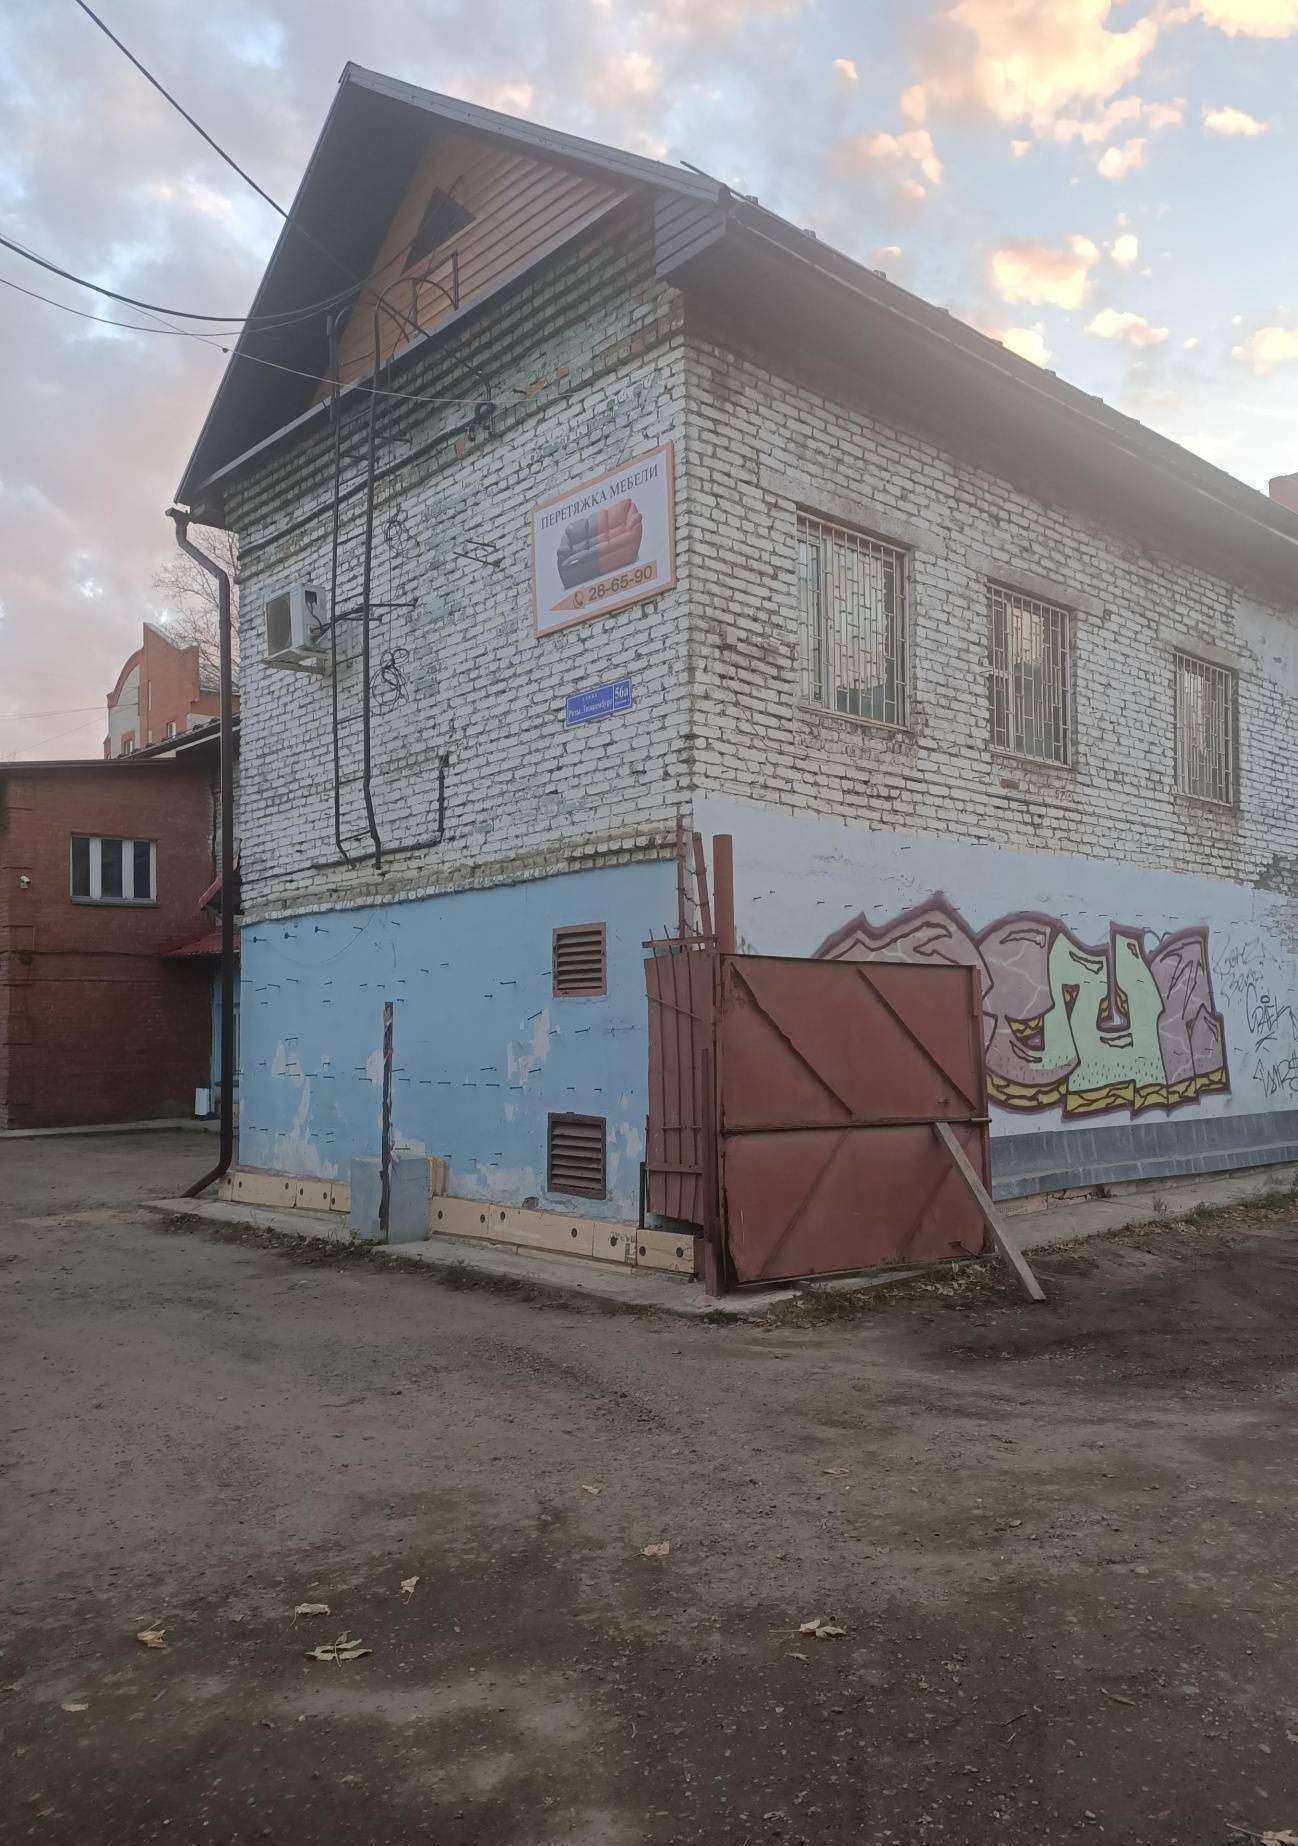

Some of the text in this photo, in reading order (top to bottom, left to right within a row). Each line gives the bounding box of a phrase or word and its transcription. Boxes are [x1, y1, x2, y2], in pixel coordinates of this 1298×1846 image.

[541, 463, 659, 530] ПЕРЕТЯЖКА МЕБЕЛИ
[588, 565, 653, 600] 28-65-90
